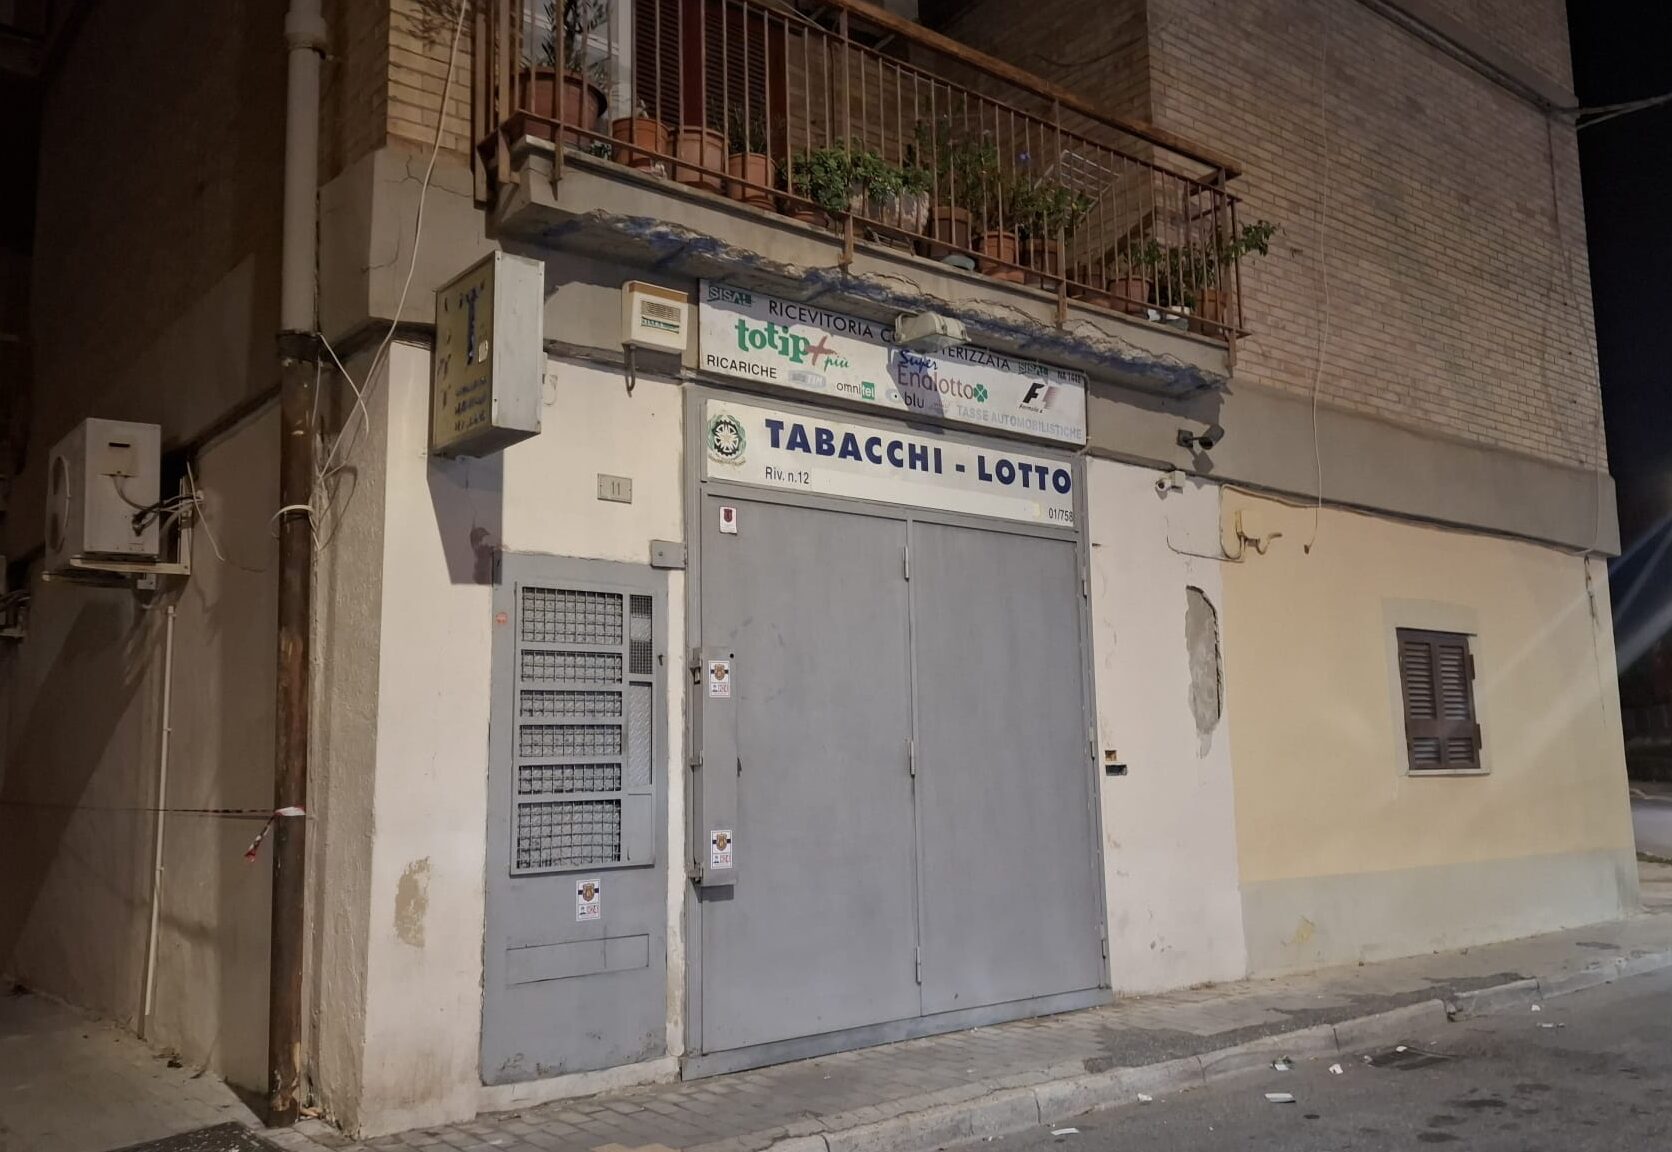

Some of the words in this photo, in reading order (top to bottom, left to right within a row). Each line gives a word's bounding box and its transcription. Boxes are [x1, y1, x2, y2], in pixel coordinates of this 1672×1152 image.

[769, 300, 873, 338] RICEVITORIA
[881, 329, 1010, 370] CERIZZATA
[707, 355, 777, 379] RICARICHE
[823, 354, 851, 372] più
[898, 349, 938, 372] Super
[836, 382, 875, 399] omnitel
[897, 364, 974, 399] Enalotto
[904, 392, 925, 409] blu
[957, 405, 988, 422] TASSE
[992, 413, 1082, 439] AUTOMOBILISTICHE
[765, 418, 942, 474] TABACCHI
[978, 455, 1072, 495] LOTTO
[765, 466, 785, 481] Riv.
[788, 470, 810, 484] n.12
